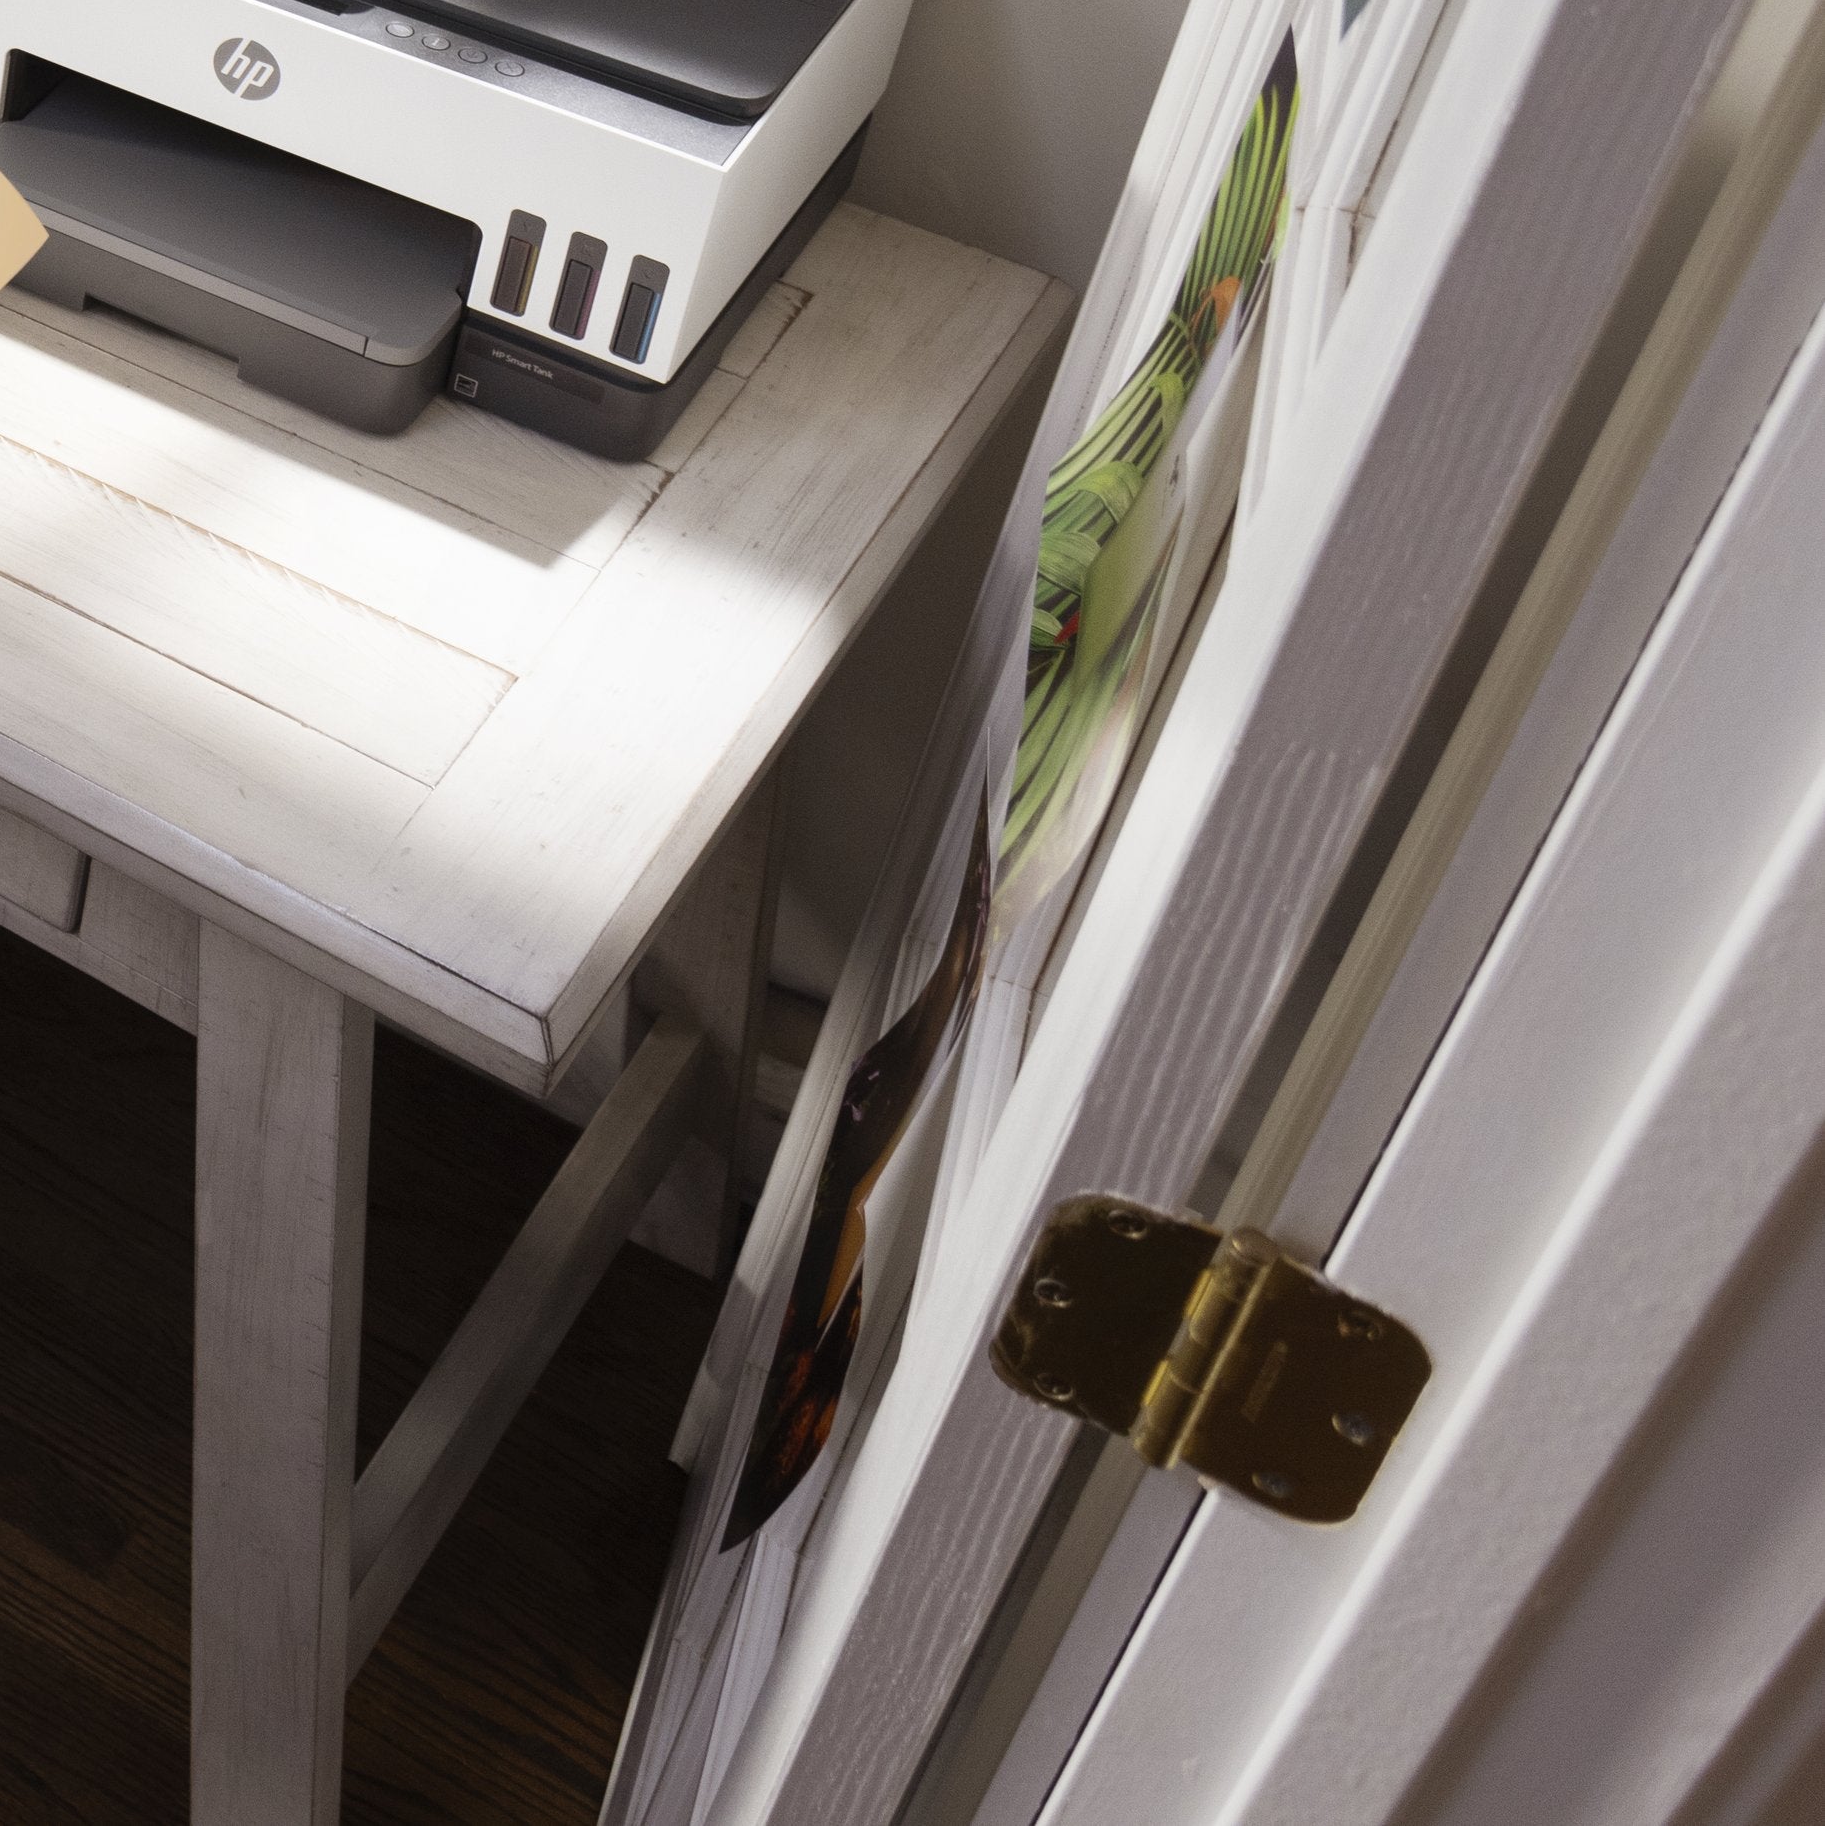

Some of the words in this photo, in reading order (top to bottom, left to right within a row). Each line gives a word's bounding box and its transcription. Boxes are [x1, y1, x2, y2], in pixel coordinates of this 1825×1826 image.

[214, 38, 279, 100] hp
[492, 349, 505, 359] HP
[506, 354, 533, 372] Smart
[533, 365, 554, 380] Tank
